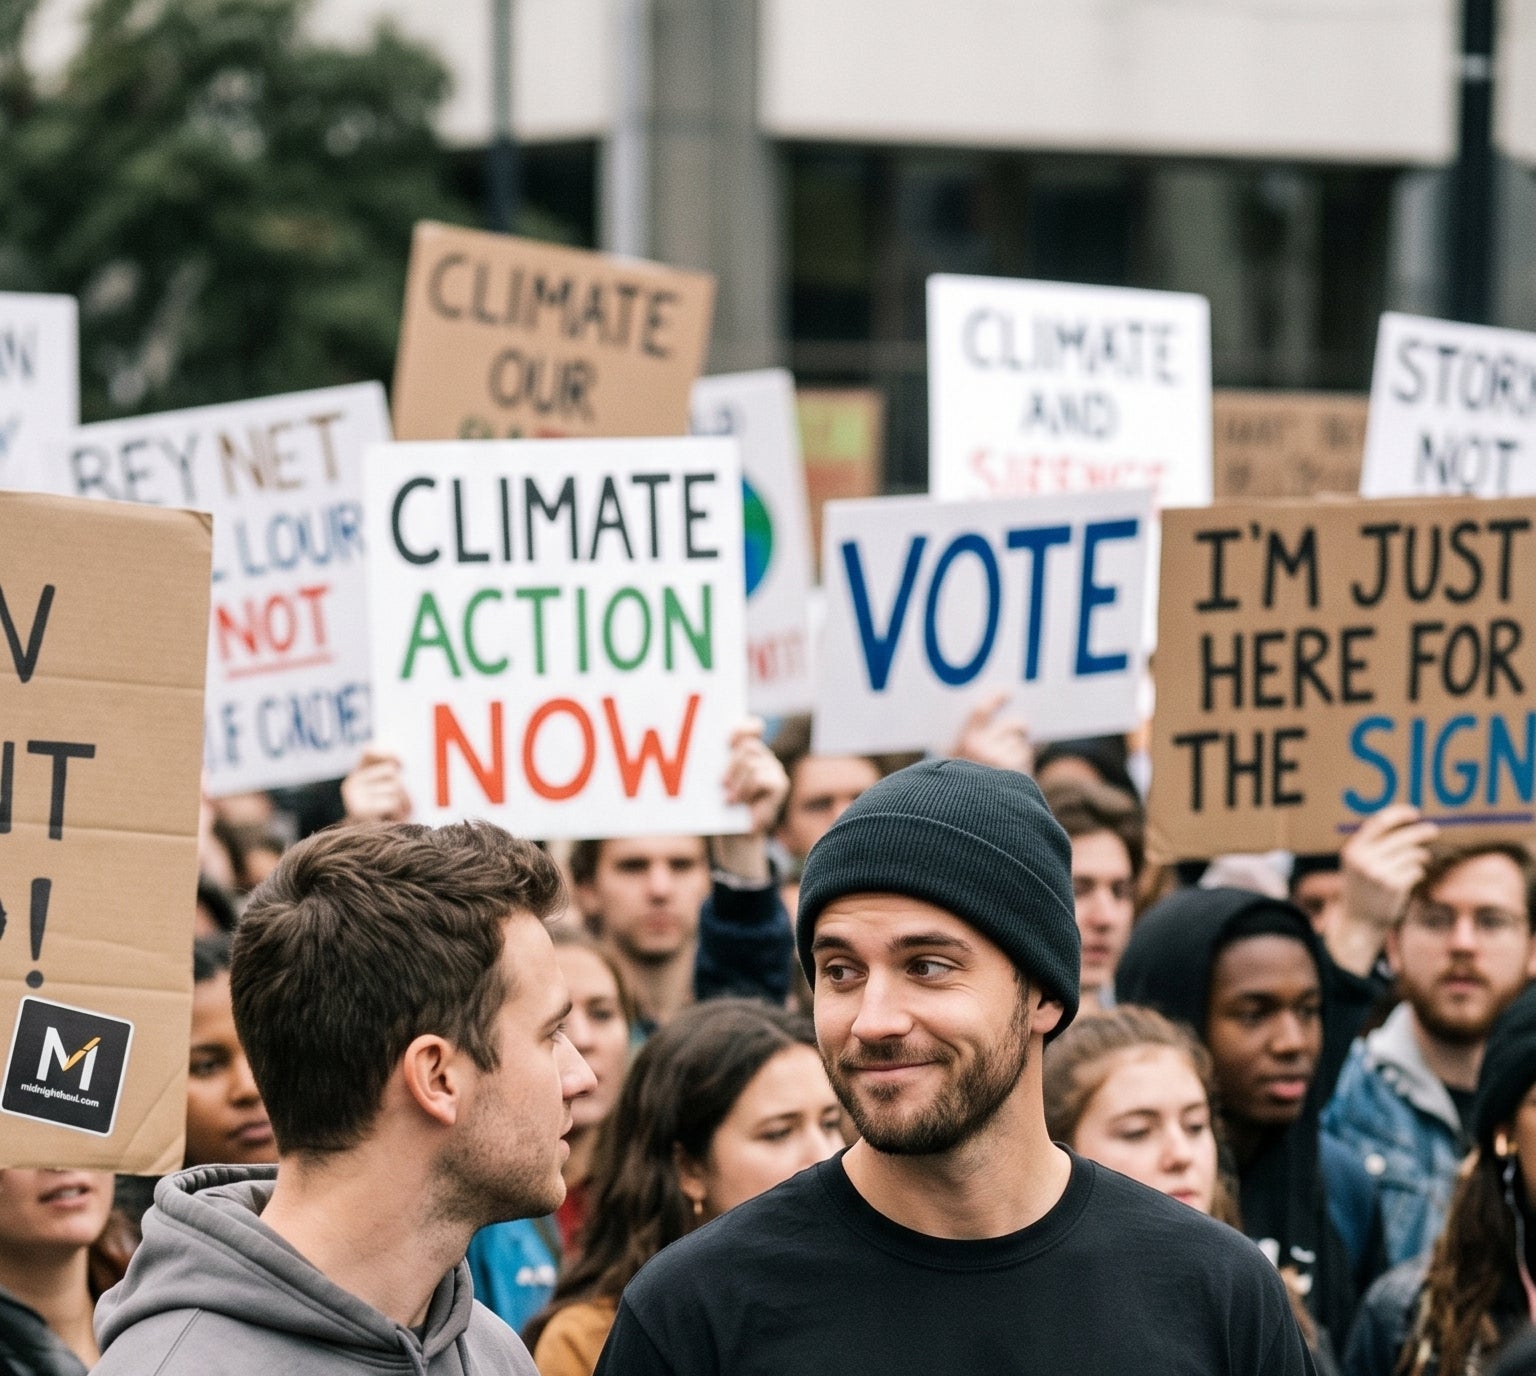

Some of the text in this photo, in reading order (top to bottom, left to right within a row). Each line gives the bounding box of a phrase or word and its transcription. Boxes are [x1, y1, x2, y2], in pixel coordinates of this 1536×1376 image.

[427, 252, 678, 357] CLIMATE
[963, 308, 1181, 383] CLIMATE
[488, 349, 597, 421] OUR
[1022, 388, 1119, 440] AND
[217, 410, 345, 496] NET
[392, 473, 719, 565] CLIMATE
[1194, 518, 1531, 613] I'M JUST
[215, 583, 331, 662] NOT
[399, 584, 713, 680] ACTION
[841, 518, 1139, 692] VOTE
[1201, 618, 1525, 711] HERE FOR
[434, 694, 701, 807] NOW
[1173, 711, 1536, 815] THE SIGN
